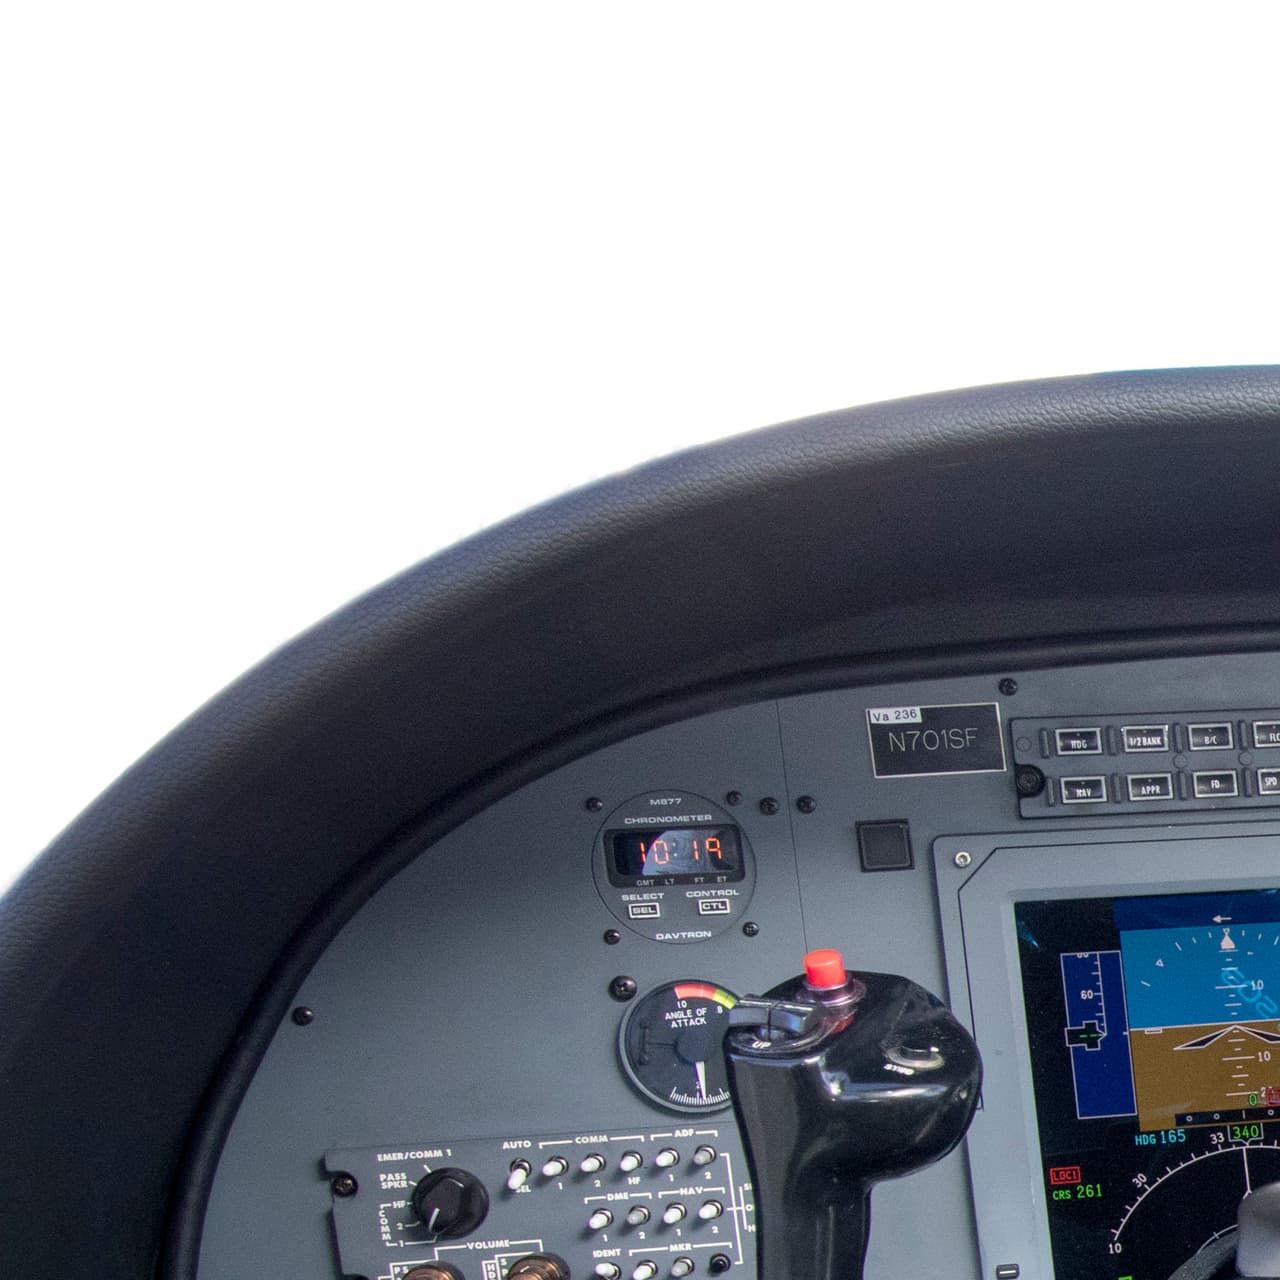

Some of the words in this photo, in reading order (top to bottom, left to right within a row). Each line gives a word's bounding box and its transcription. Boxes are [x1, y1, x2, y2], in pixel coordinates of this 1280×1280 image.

[873, 711, 890, 723] Va
[893, 709, 918, 721] 236
[889, 727, 978, 753] N701SF
[1141, 785, 1161, 795] APPR
[624, 814, 712, 825] CHRONOMETER
[621, 892, 665, 901] SELECT
[686, 888, 740, 898] CONTROL
[656, 930, 712, 940] DAVTRON
[665, 1010, 693, 1021] ANGLE
[696, 1008, 707, 1017] OF
[671, 1016, 707, 1028] ATTACK
[674, 1129, 694, 1138] ADF
[1135, 1135, 1156, 1145] HDG
[1160, 1129, 1186, 1144] 165
[1232, 1126, 1259, 1138] 340
[503, 1140, 531, 1149] AUTO
[575, 1135, 608, 1144] COMM
[378, 1150, 443, 1161] EMER/COMM
[447, 1149, 452, 1157] 1
[1052, 1189, 1071, 1200] CRS
[1077, 1184, 1102, 1198] 261
[467, 1239, 510, 1249] VOLUME
